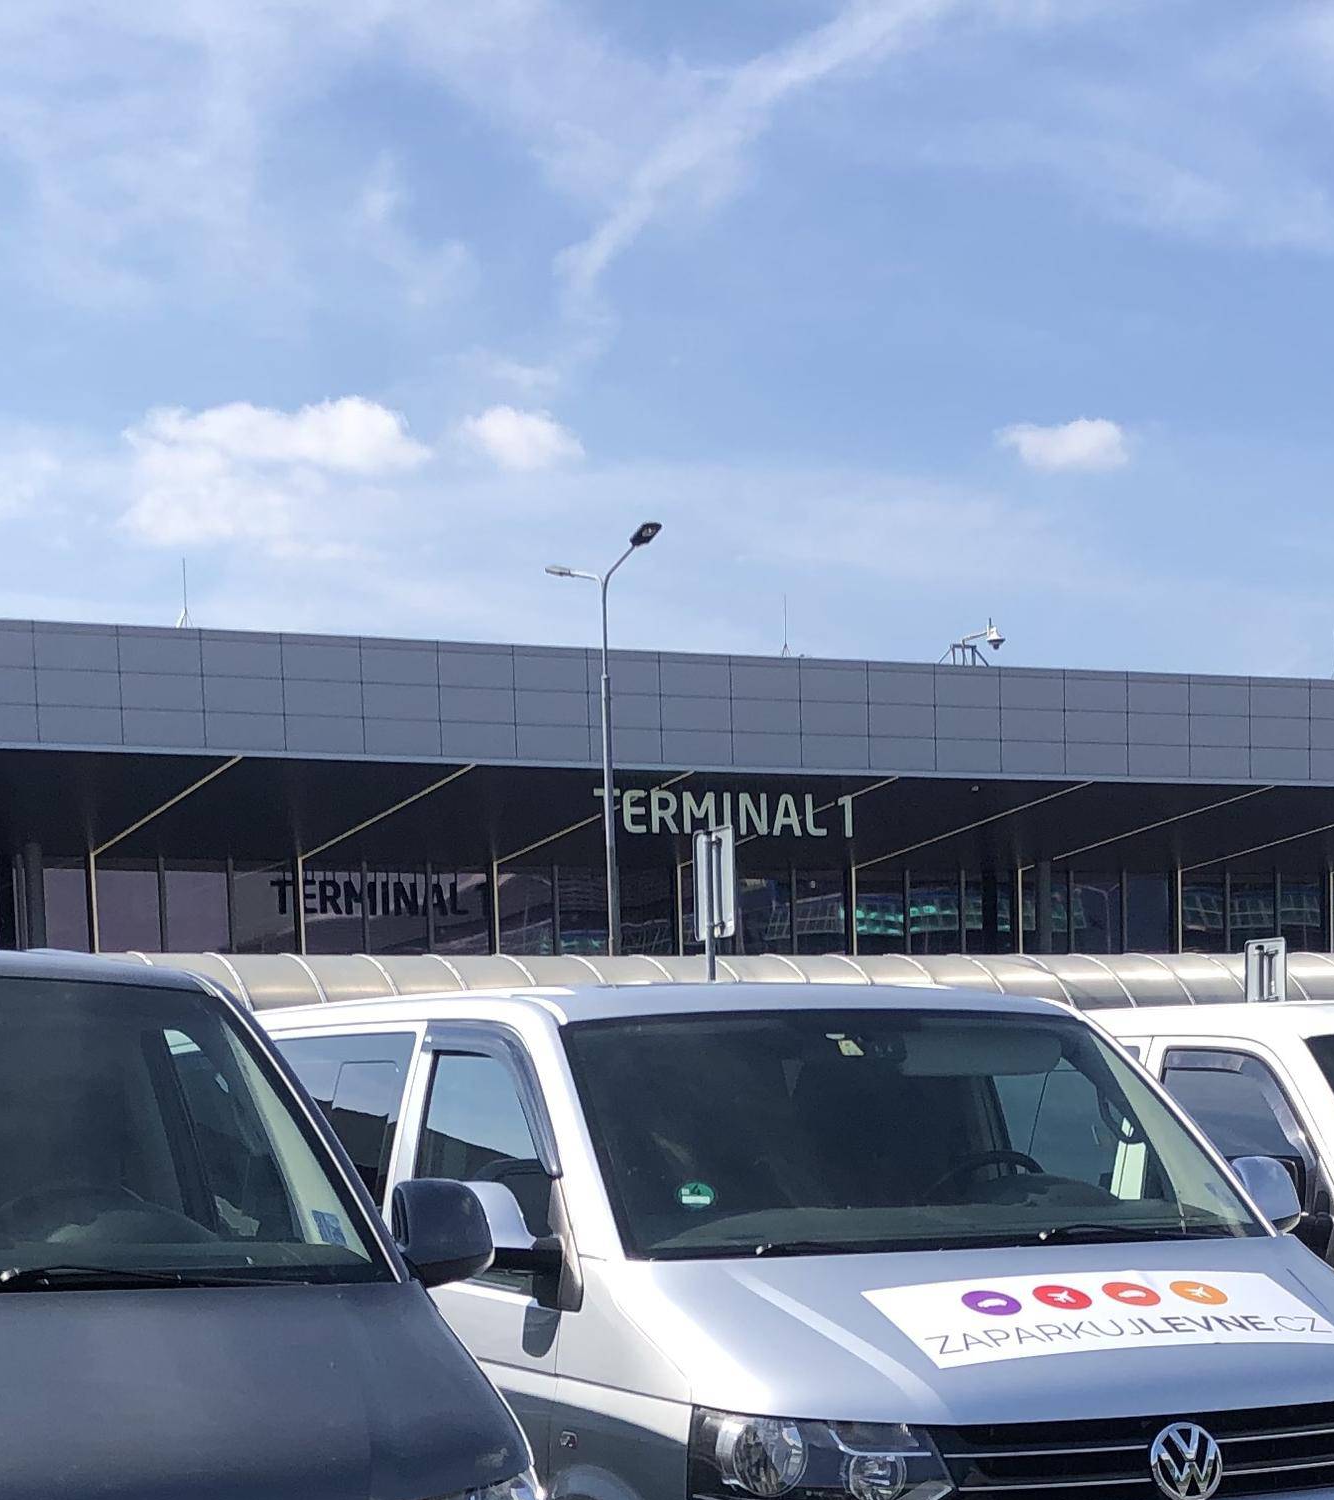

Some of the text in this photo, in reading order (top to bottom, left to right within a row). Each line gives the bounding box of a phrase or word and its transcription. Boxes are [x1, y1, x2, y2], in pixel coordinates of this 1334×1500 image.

[838, 795, 854, 838] 1
[270, 877, 469, 917] TERMINAL
[923, 1314, 1333, 1356] ZAPARKUJLEVNE.CZ
